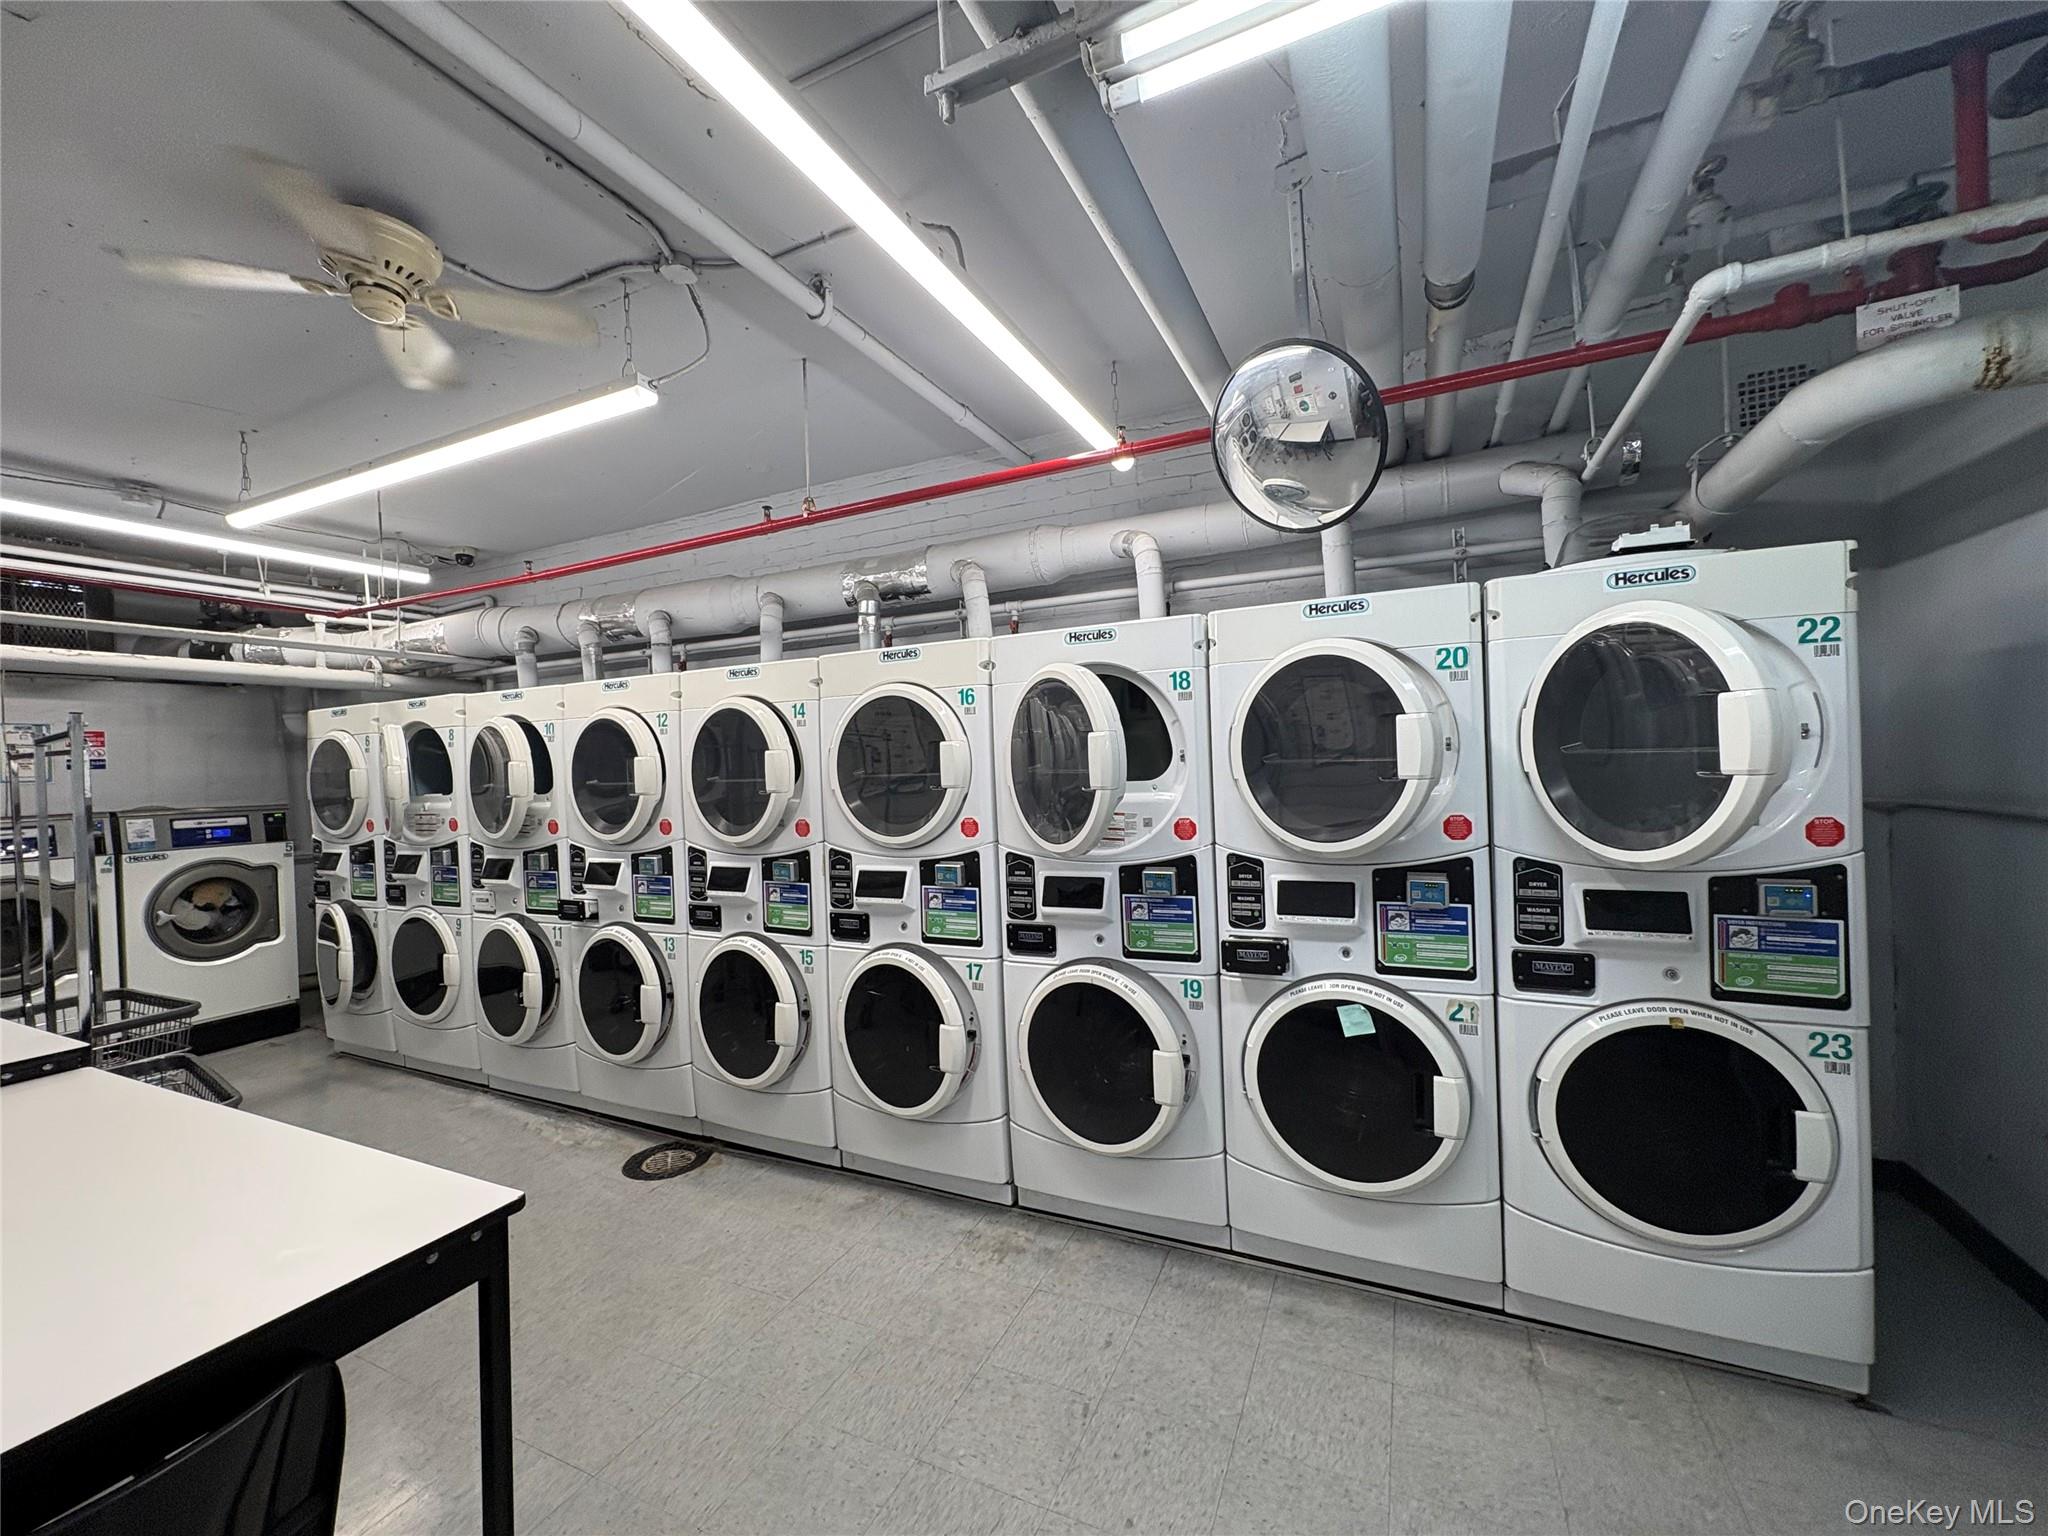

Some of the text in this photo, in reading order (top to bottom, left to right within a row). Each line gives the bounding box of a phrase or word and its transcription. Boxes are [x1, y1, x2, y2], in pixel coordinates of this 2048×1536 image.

[1877, 296, 1937, 315] SHUT-OFF
[1891, 308, 1924, 321] VALVE
[1863, 313, 1953, 338] FOR SPRINKLER
[1614, 567, 1690, 586] Hercules
[1308, 600, 1365, 615] Hercules
[1069, 629, 1113, 642] Hercules
[1797, 616, 1841, 644] 22
[882, 649, 918, 660] Hercules
[1436, 646, 1469, 670] 20
[729, 668, 758, 678] Hercules
[1169, 671, 1191, 690] 18
[957, 688, 975, 705] 16
[792, 703, 806, 718] 14
[656, 713, 668, 727] 12
[448, 729, 454, 740] 8
[544, 722, 554, 735] 10
[285, 843, 293, 852] 5
[104, 857, 113, 867] 4
[456, 918, 461, 929] 9
[552, 926, 562, 939] 11
[663, 937, 675, 952] 13
[800, 950, 814, 965] 15
[966, 963, 983, 980] 17
[1535, 962, 1572, 972] MAYTAG
[1180, 979, 1202, 998] 19
[1356, 986, 1373, 995] WHEN
[1374, 991, 1386, 999] NOT
[1393, 999, 1404, 1008] USE
[1599, 1010, 1623, 1022] PLEASE
[1624, 1006, 1645, 1016] LEAVE
[1669, 1006, 1689, 1015] OPEN
[1690, 1009, 1713, 1020] WHEN
[1714, 1015, 1728, 1024] NOT
[1730, 1020, 1738, 1029] IN
[1740, 1025, 1754, 1036] USE
[1808, 1032, 1853, 1060] 23
